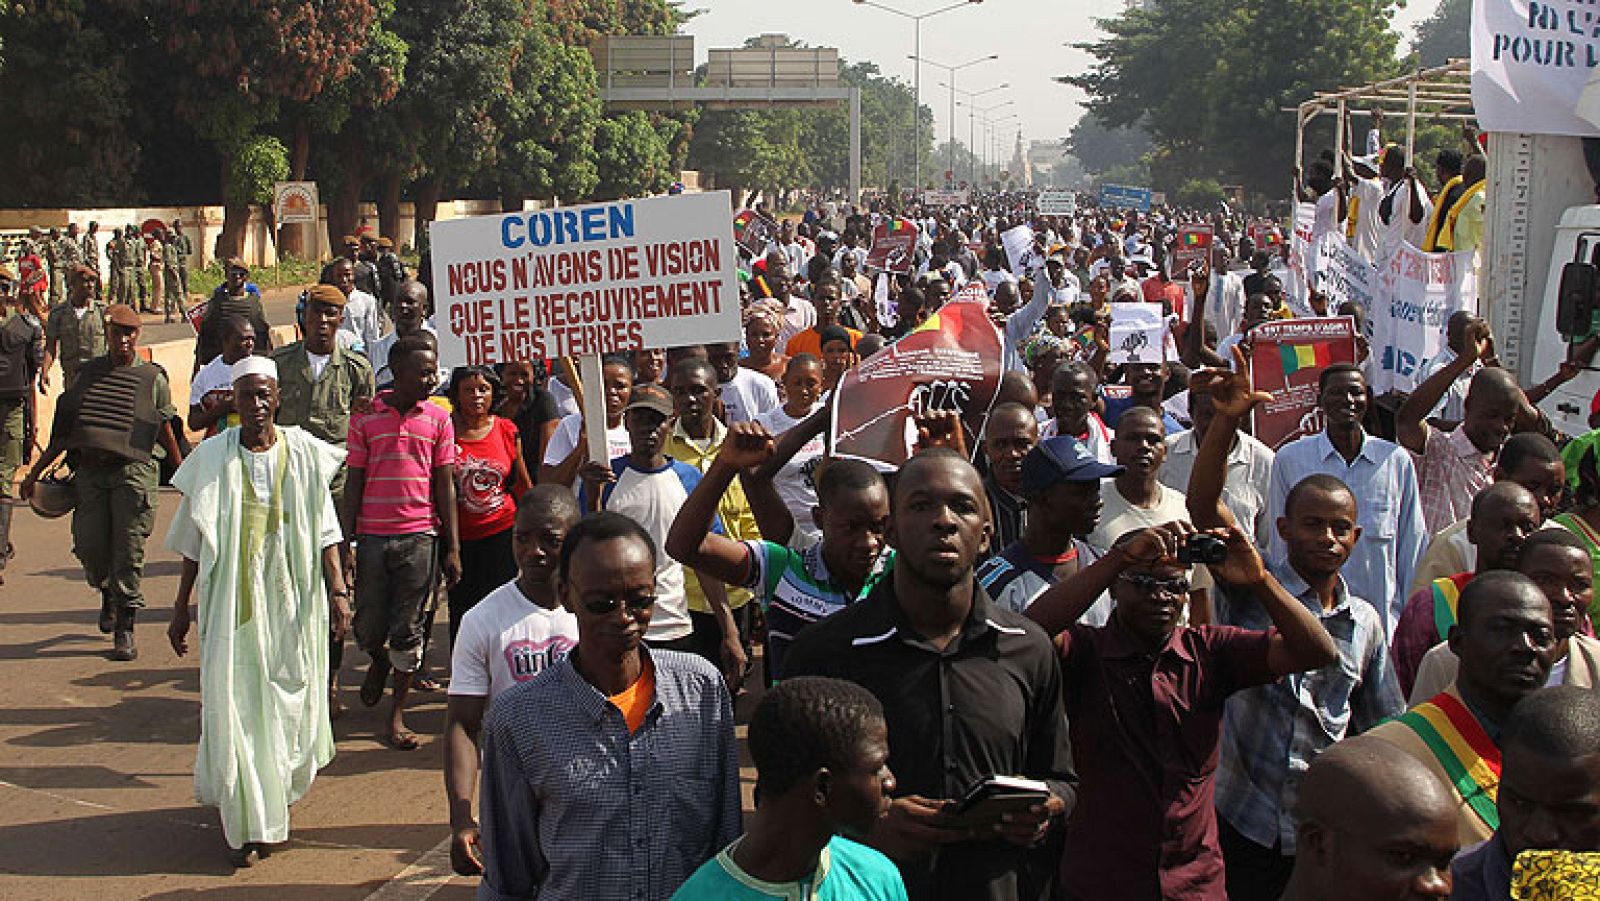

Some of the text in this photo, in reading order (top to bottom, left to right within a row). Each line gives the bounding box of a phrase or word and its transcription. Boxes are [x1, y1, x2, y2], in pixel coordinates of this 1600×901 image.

[1493, 33, 1575, 67] POUR
[501, 203, 635, 249] COREN
[448, 239, 720, 296] NOUS N'AVONS DE VISION
[450, 280, 722, 338] QUE LE RECOUVREMENT
[466, 321, 644, 366] DE NOS TERRES
